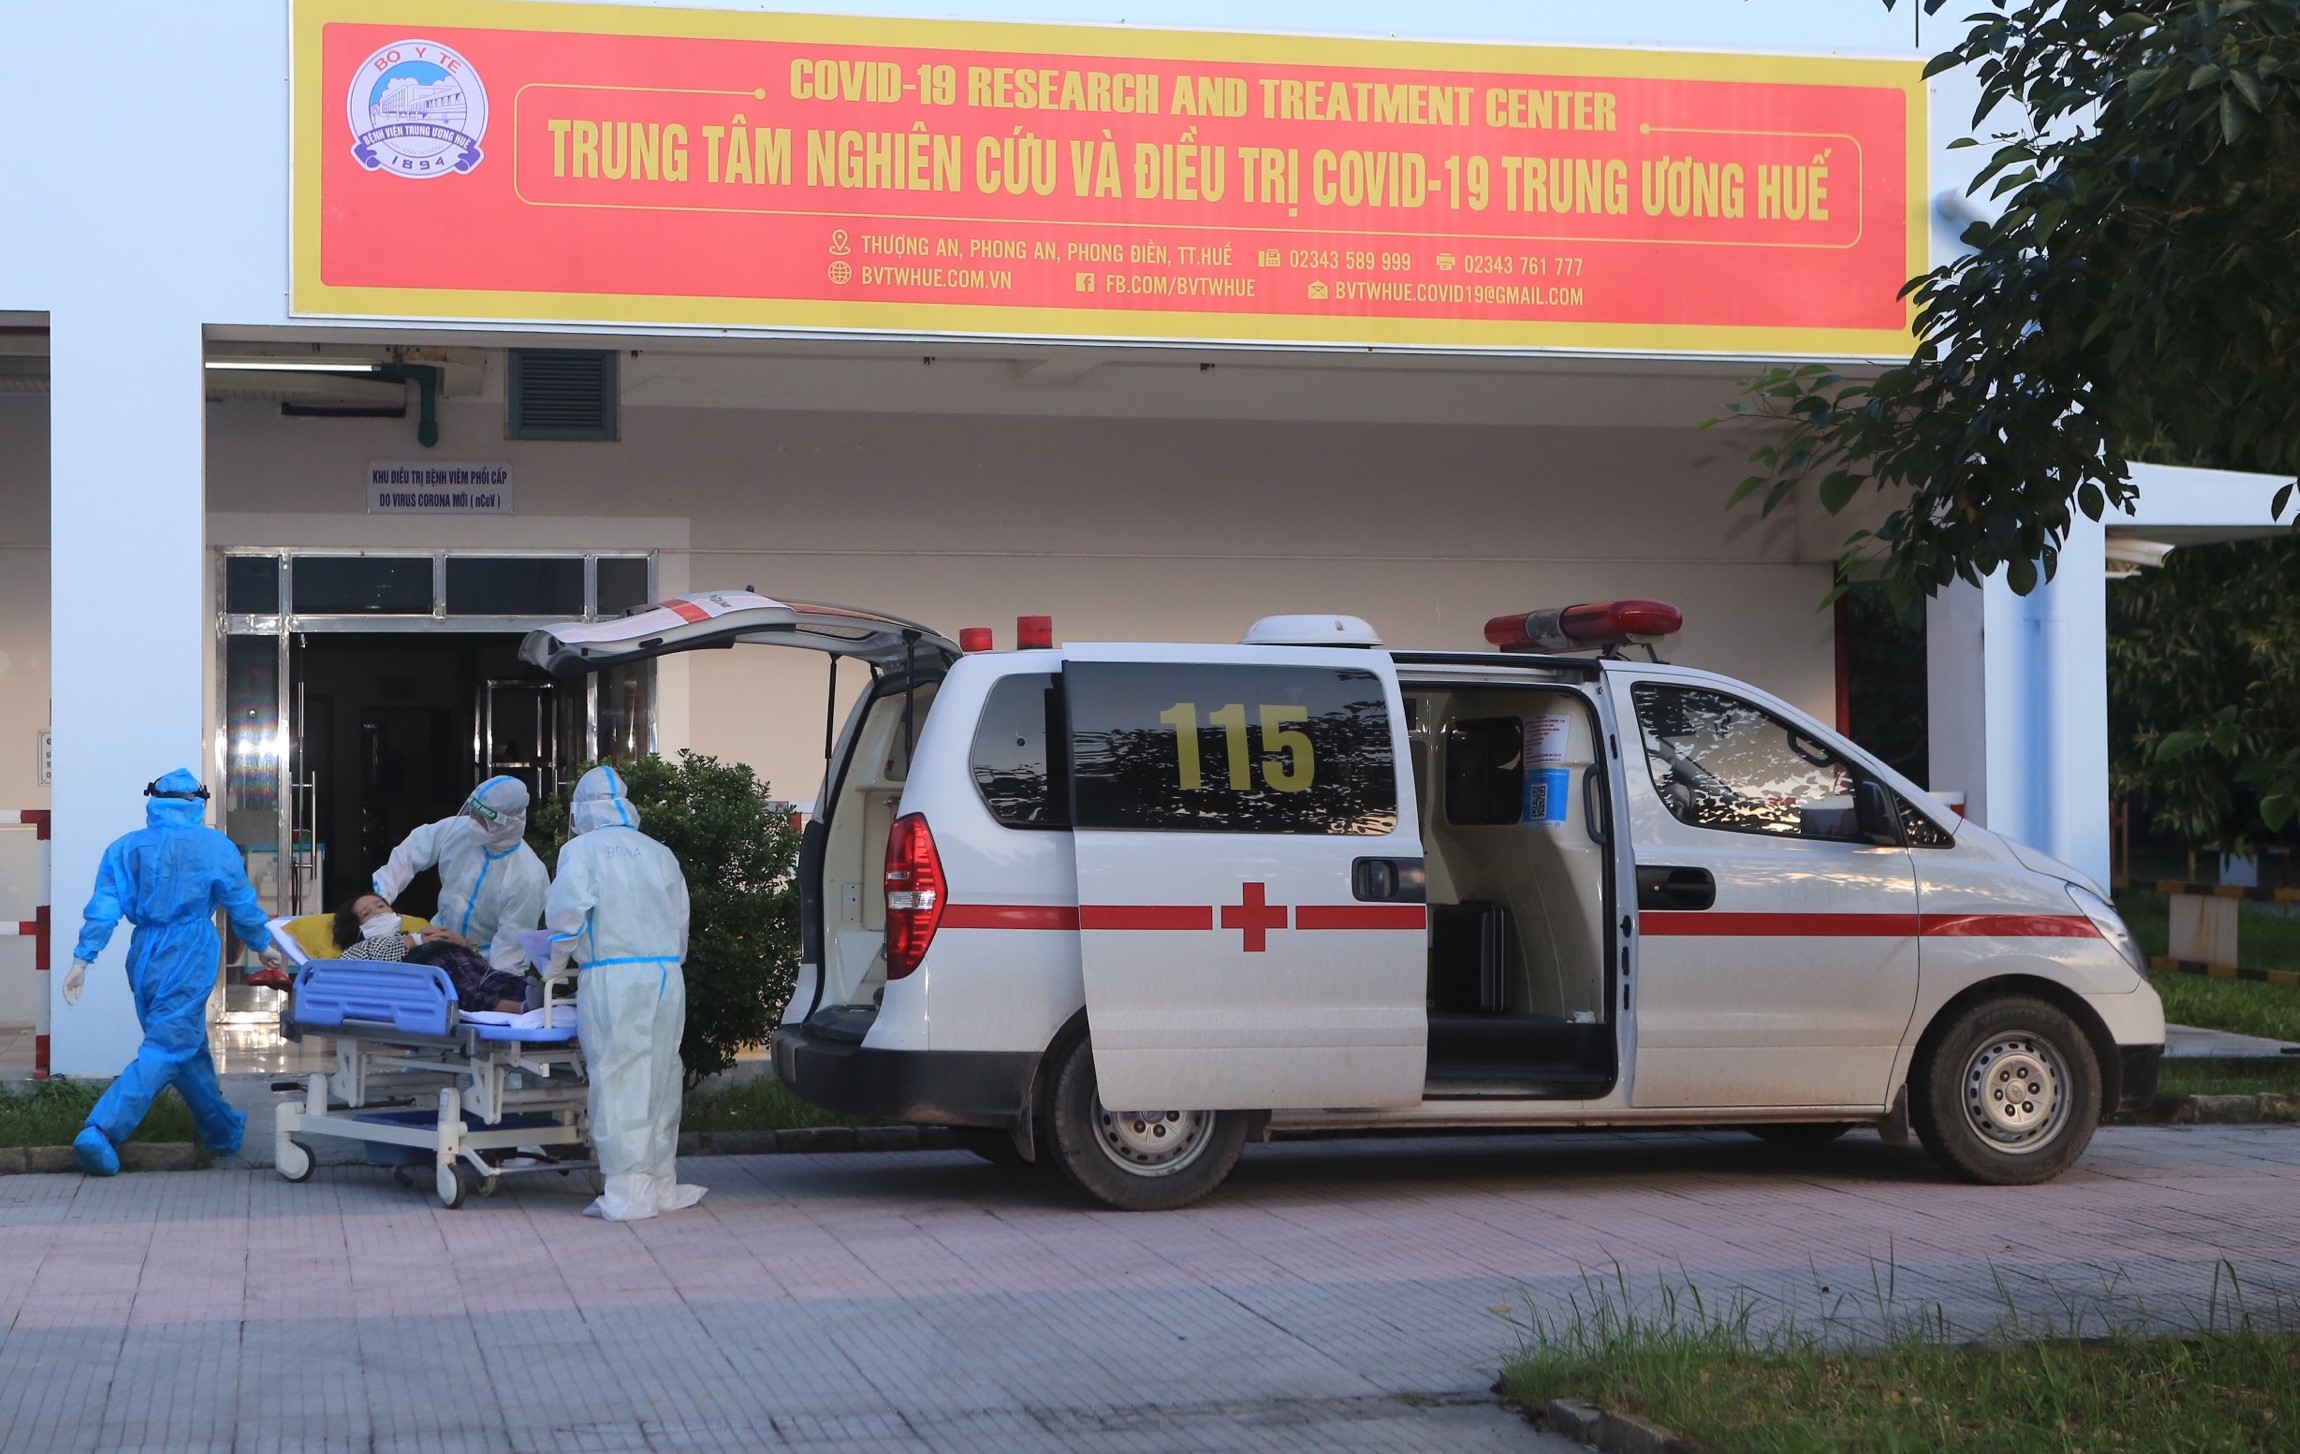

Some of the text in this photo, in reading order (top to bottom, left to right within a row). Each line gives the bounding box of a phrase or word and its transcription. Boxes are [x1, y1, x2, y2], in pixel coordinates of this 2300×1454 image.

[415, 47, 427, 58] Y
[790, 58, 1617, 132] COVID-19 RESEARCH AND TREATMENT CENTER
[404, 125, 431, 136] TRUNG
[391, 155, 446, 171] 1894
[548, 114, 1832, 222] TRUNG TÂM NGHIÊN CỨU VÀ ĐIỀU TRỊ COVID-19 TRUNG ƯƠNG HUẾ
[861, 234, 1233, 267] THƯỢNG AN, PHONG AN, PHONG ĐIỀN, TT.HUẾ
[1289, 250, 1411, 272] 02343 589 999
[861, 264, 1012, 289] BVTWHUE.COM.VN
[1464, 255, 1584, 276] 02343 761 777
[1106, 273, 1255, 297] FB.COM/BVTWHUE
[1335, 280, 1584, 306] BVTWHUE.COVID19@GMAIL.COM
[372, 469, 389, 484] KHU
[411, 470, 424, 487] TRỊ
[426, 468, 447, 487] BỆNH
[448, 468, 468, 484] VIÊM
[491, 466, 507, 484] CẤP
[379, 493, 391, 507] DO
[392, 493, 416, 507] VIRUS
[418, 493, 450, 507] CORONA
[452, 491, 468, 507] MỚI
[1159, 702, 1315, 793] 115
